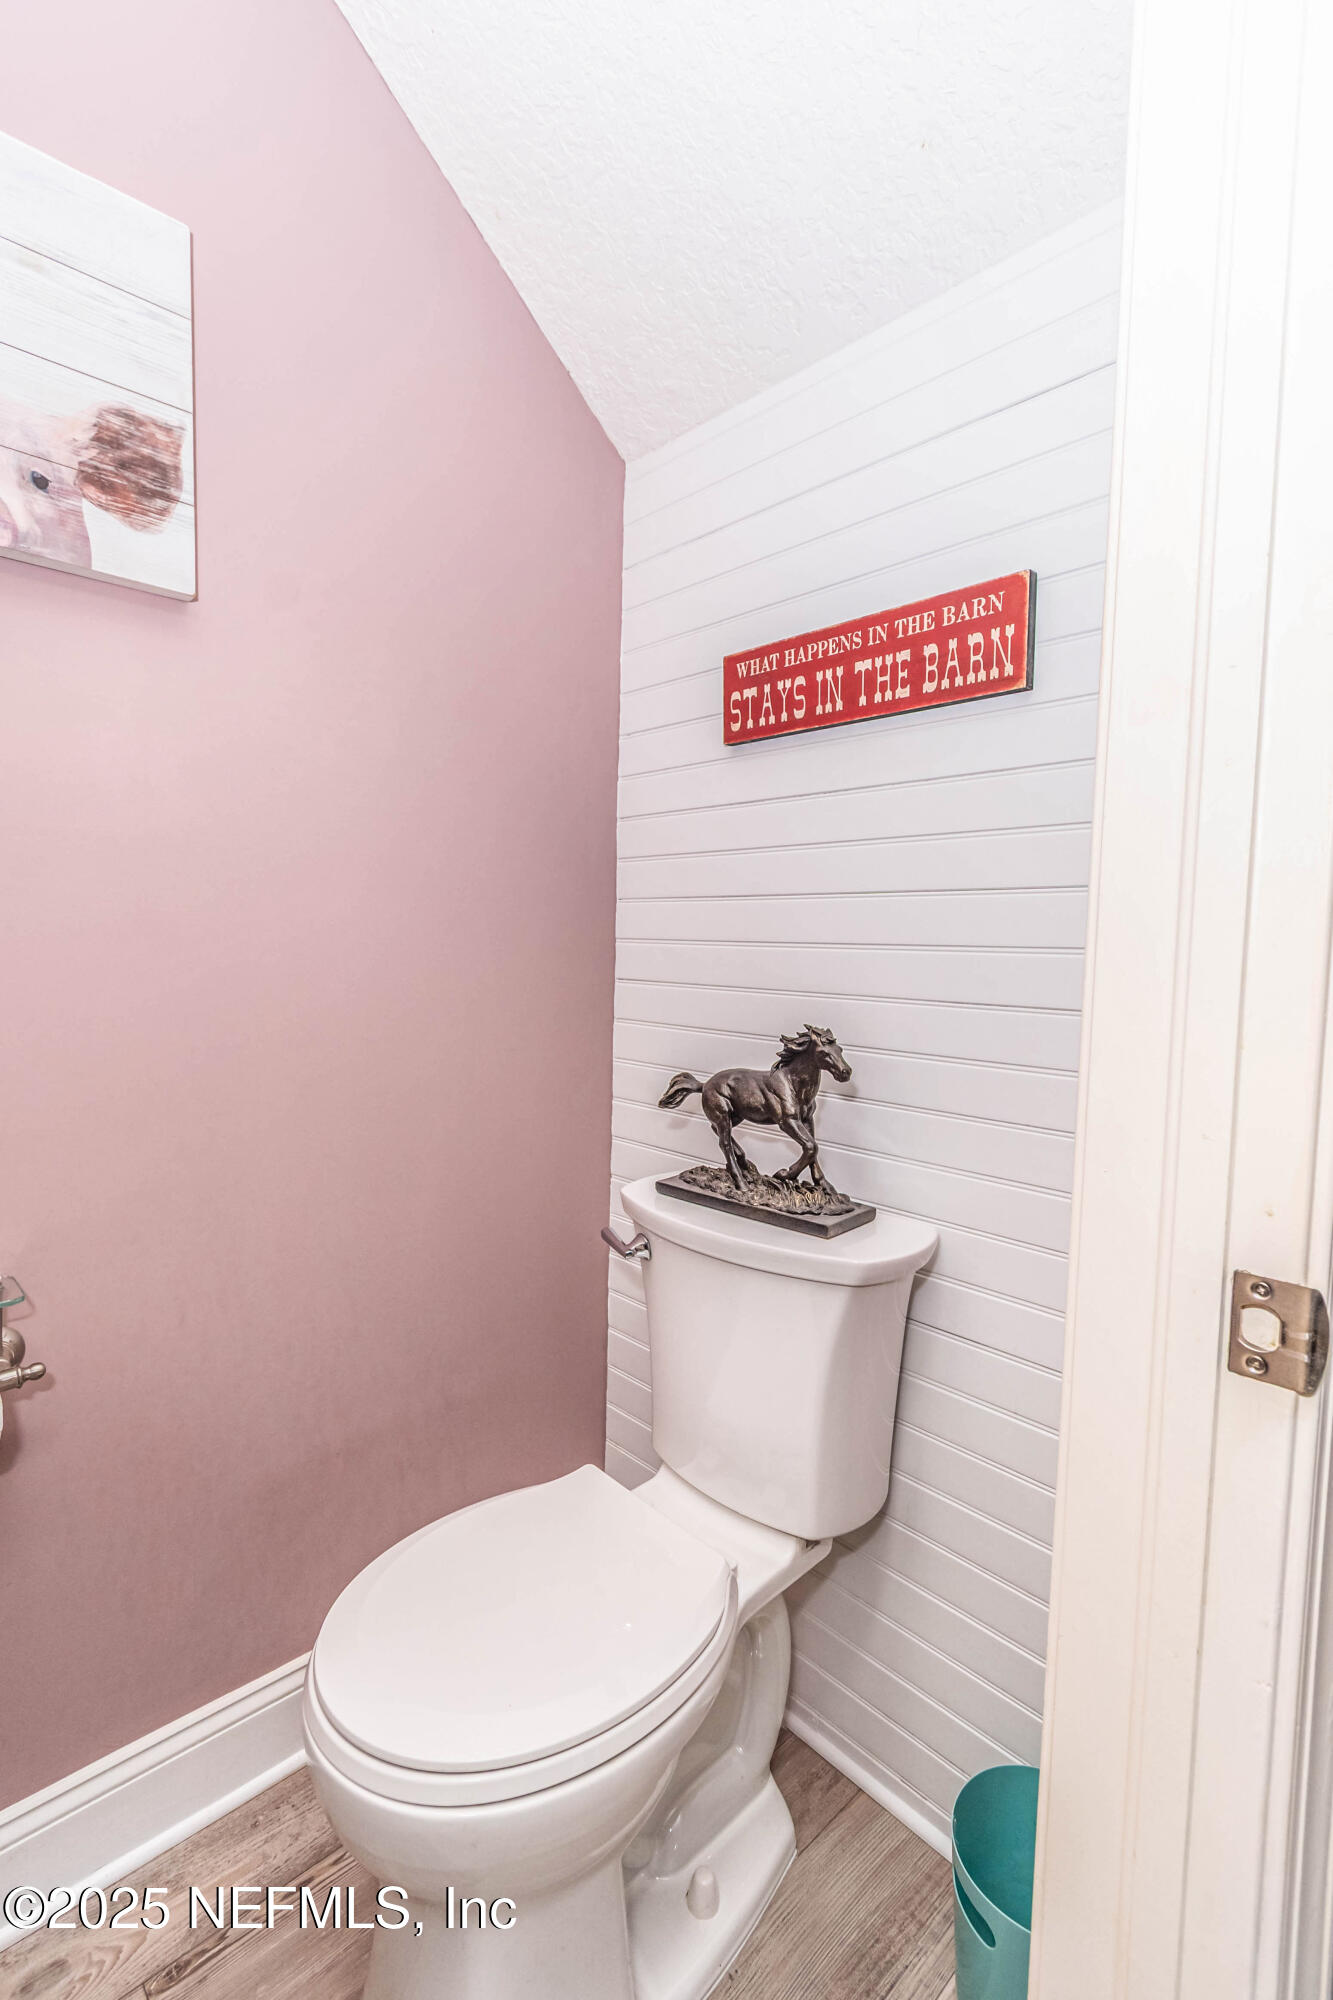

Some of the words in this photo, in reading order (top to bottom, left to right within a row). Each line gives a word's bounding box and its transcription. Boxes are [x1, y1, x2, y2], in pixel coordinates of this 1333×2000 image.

[729, 674, 807, 732] STAYS
[815, 666, 844, 715] IN
[854, 649, 911, 703] THE
[922, 624, 1016, 693] BARN
[735, 650, 780, 677] WHAT
[783, 630, 863, 667] HAPPENS
[867, 623, 889, 649] IN
[894, 612, 937, 642] THE
[942, 590, 1006, 628] BARN
